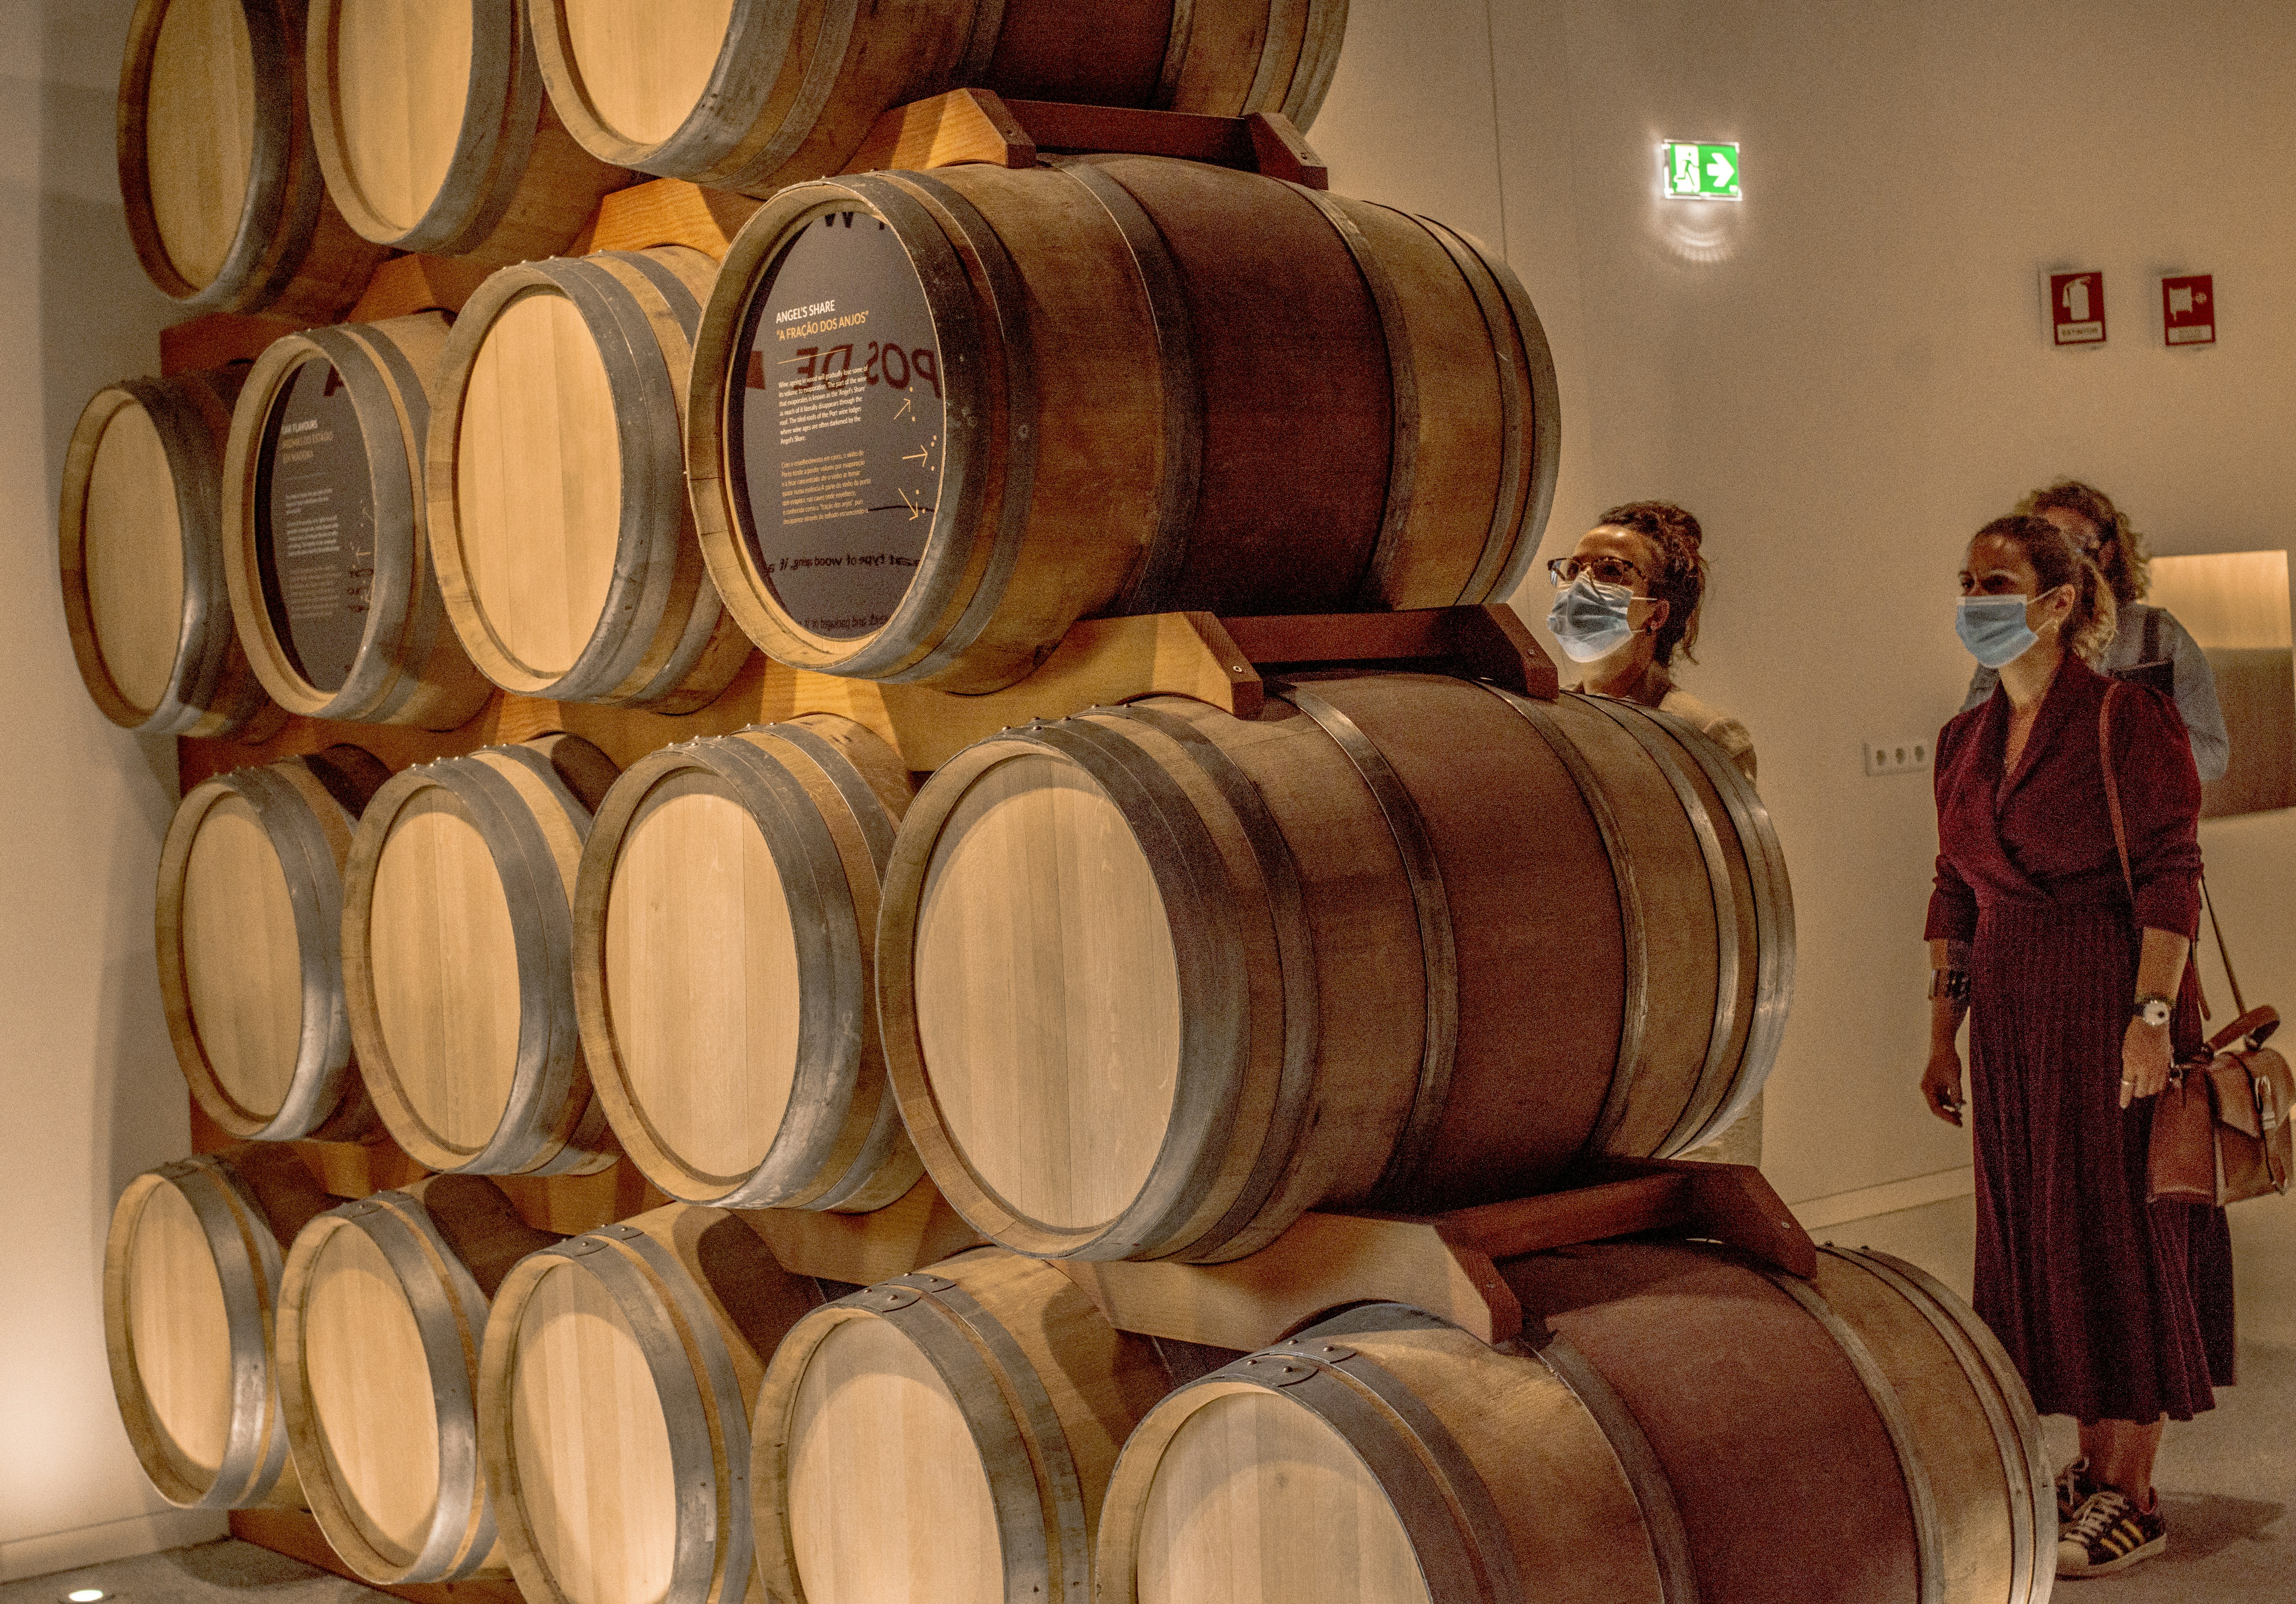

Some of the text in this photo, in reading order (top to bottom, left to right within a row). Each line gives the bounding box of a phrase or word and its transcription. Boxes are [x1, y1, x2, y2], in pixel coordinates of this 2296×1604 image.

[776, 300, 835, 324] ANGEL'S SHARE
[787, 322, 819, 339] FRAÇÃO
[820, 318, 837, 332] DOS
[825, 370, 842, 380] gradually
[787, 397, 808, 406] evaporates
[839, 397, 855, 405] through
[829, 418, 848, 426] darkened
